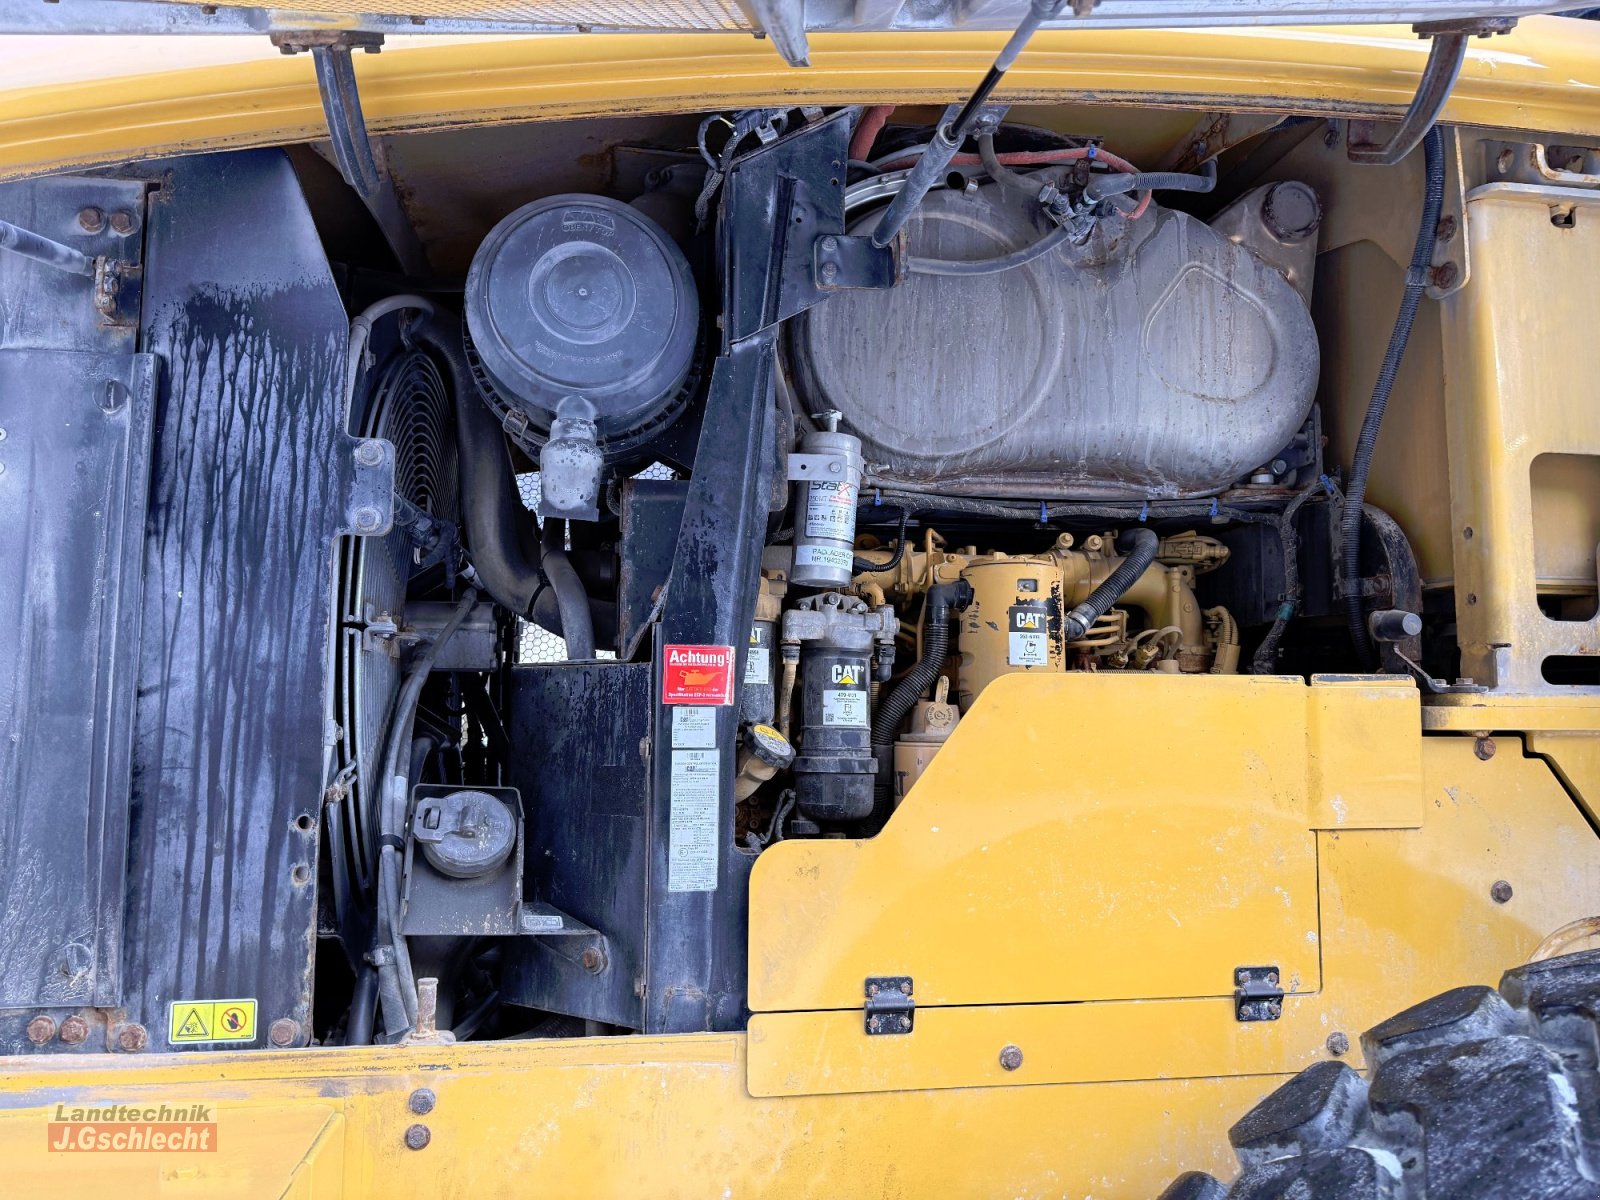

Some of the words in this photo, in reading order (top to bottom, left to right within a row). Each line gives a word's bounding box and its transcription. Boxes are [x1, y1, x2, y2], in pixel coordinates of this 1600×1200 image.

[1016, 612, 1041, 629] CAT
[669, 650, 731, 667] Achtung!
[831, 664, 862, 685] CAT
